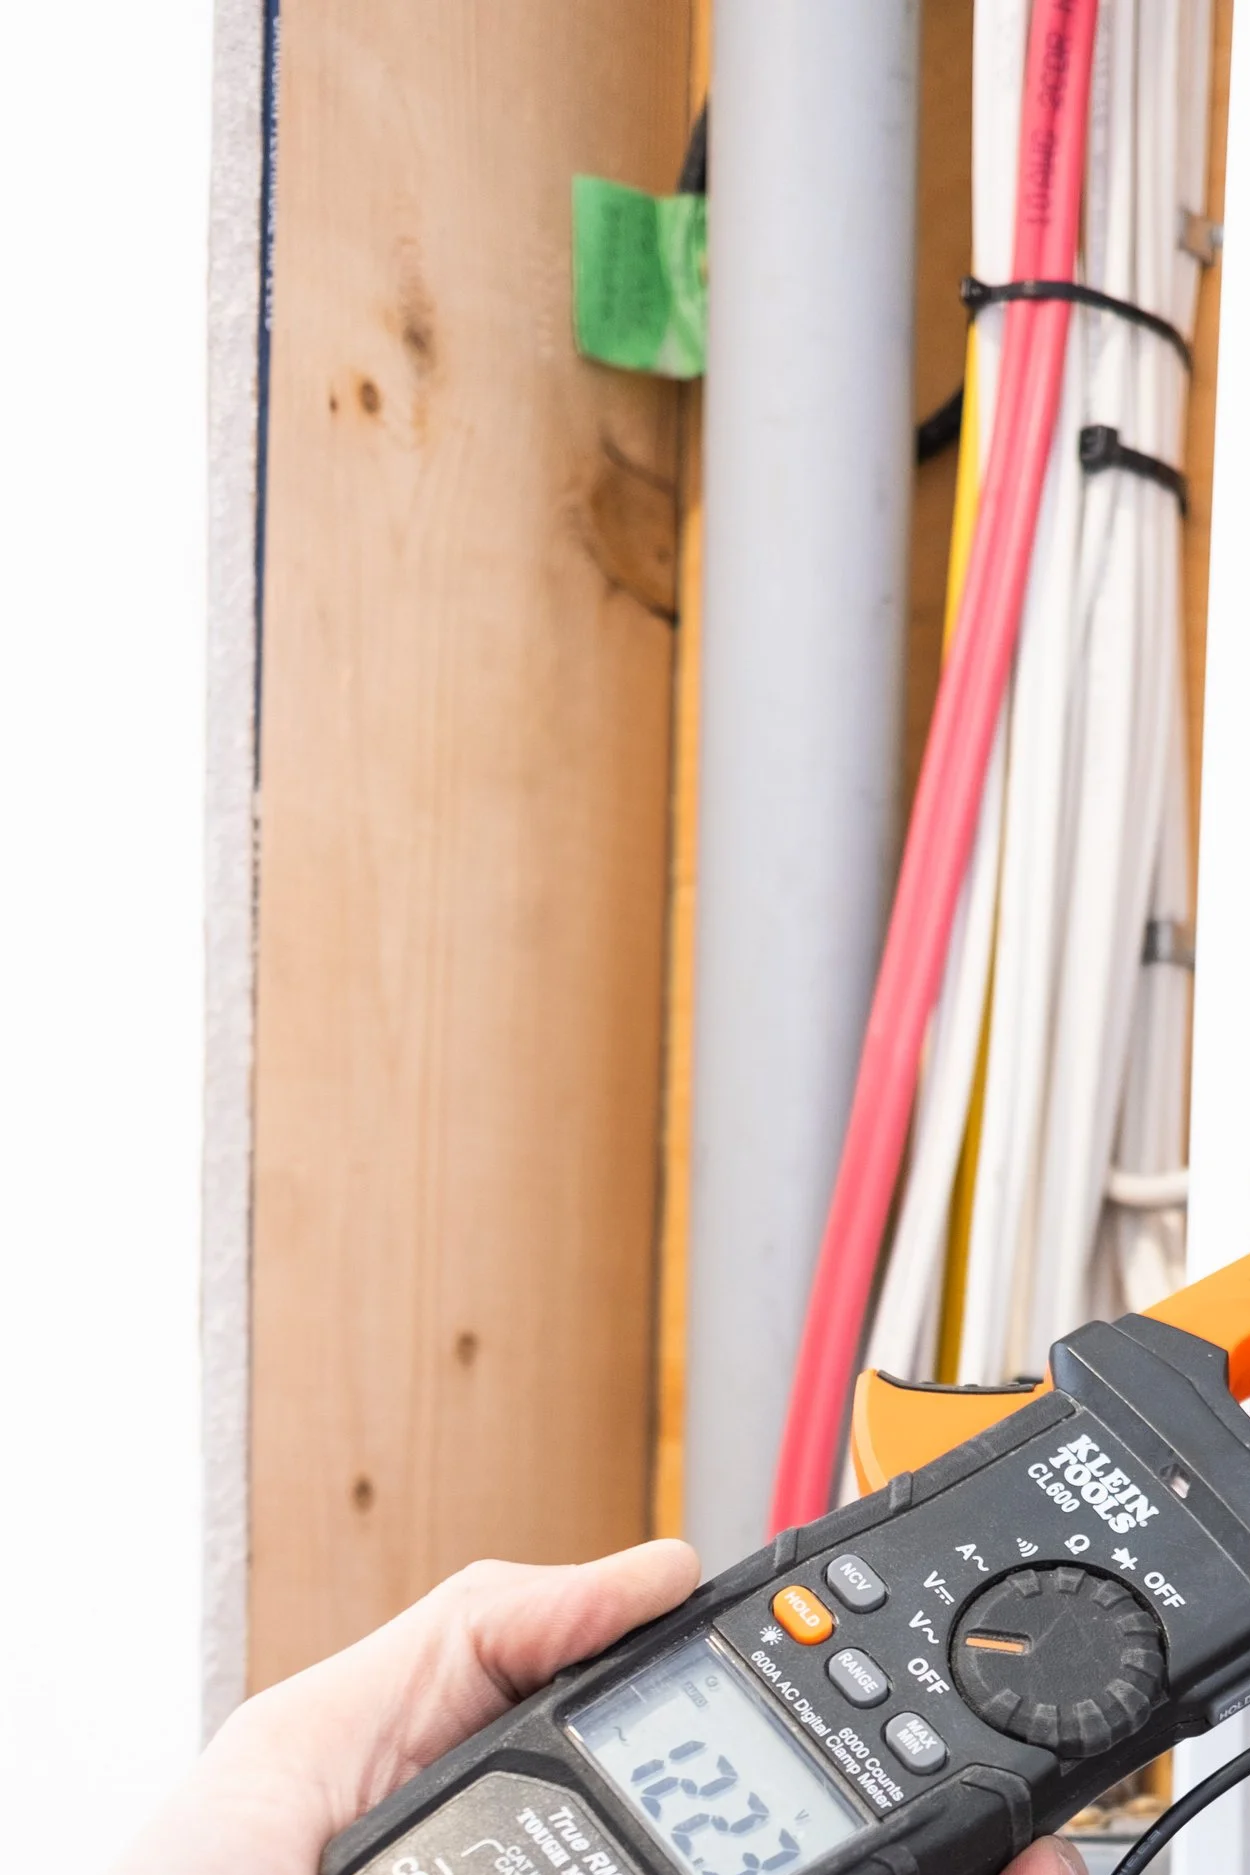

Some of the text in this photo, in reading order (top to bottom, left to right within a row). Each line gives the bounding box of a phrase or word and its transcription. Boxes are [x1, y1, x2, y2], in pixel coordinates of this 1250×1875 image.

[1028, 1463, 1080, 1513] CL600
[1050, 1446, 1137, 1534] TOOLS
[1066, 1434, 1159, 1523] KLEIN
[839, 1562, 872, 1591] NCV
[1144, 1572, 1186, 1608] OFF
[784, 1591, 821, 1627] HOLD
[837, 1652, 879, 1694] RANGE
[907, 1657, 950, 1696] OFF
[750, 1650, 893, 1810] 600A AC Digital Clamp Meter
[897, 1729, 924, 1755] MIN
[906, 1719, 938, 1749] MAX
[838, 1727, 904, 1803] 6000 Counts
[515, 1807, 572, 1868] TOUGH
[548, 1805, 590, 1852] True
[504, 1845, 534, 1872] CAT
